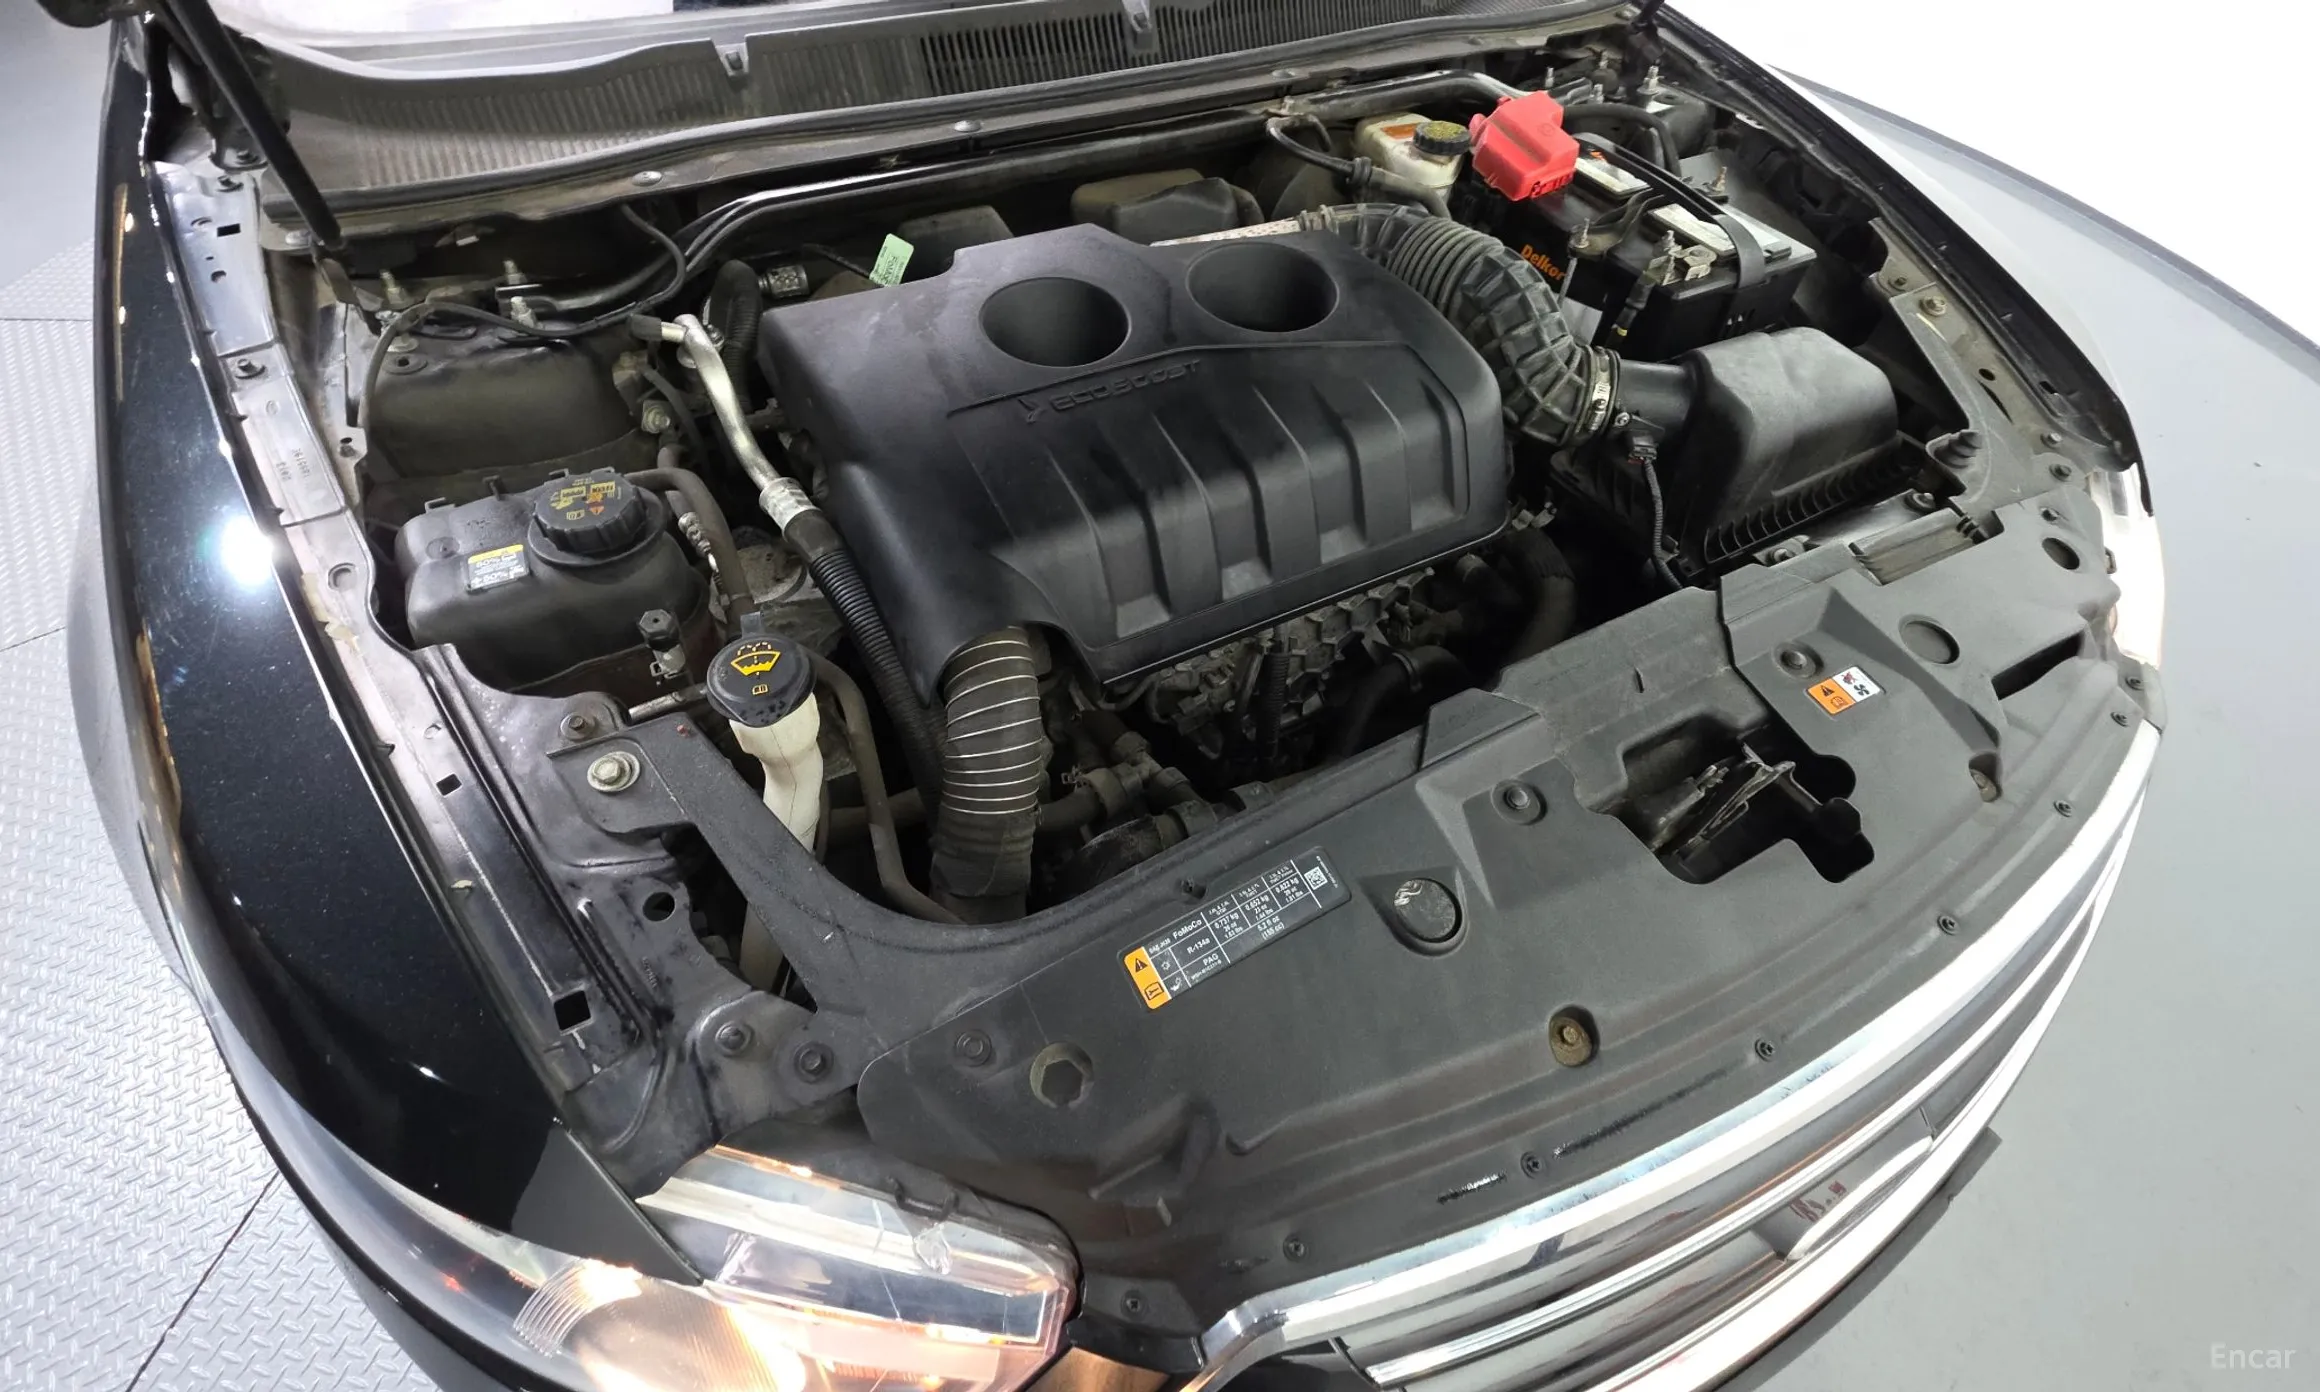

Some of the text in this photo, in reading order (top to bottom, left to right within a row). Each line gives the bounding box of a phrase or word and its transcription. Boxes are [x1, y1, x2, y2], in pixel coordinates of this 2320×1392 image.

[1520, 244, 1566, 280] Delkor
[1290, 877, 1300, 887] kg
[1260, 893, 1270, 903] kg
[1229, 911, 1239, 921] kg
[1173, 919, 1202, 939] FoMoCo
[1187, 937, 1210, 954] R-134a
[1203, 953, 1218, 966] PAG
